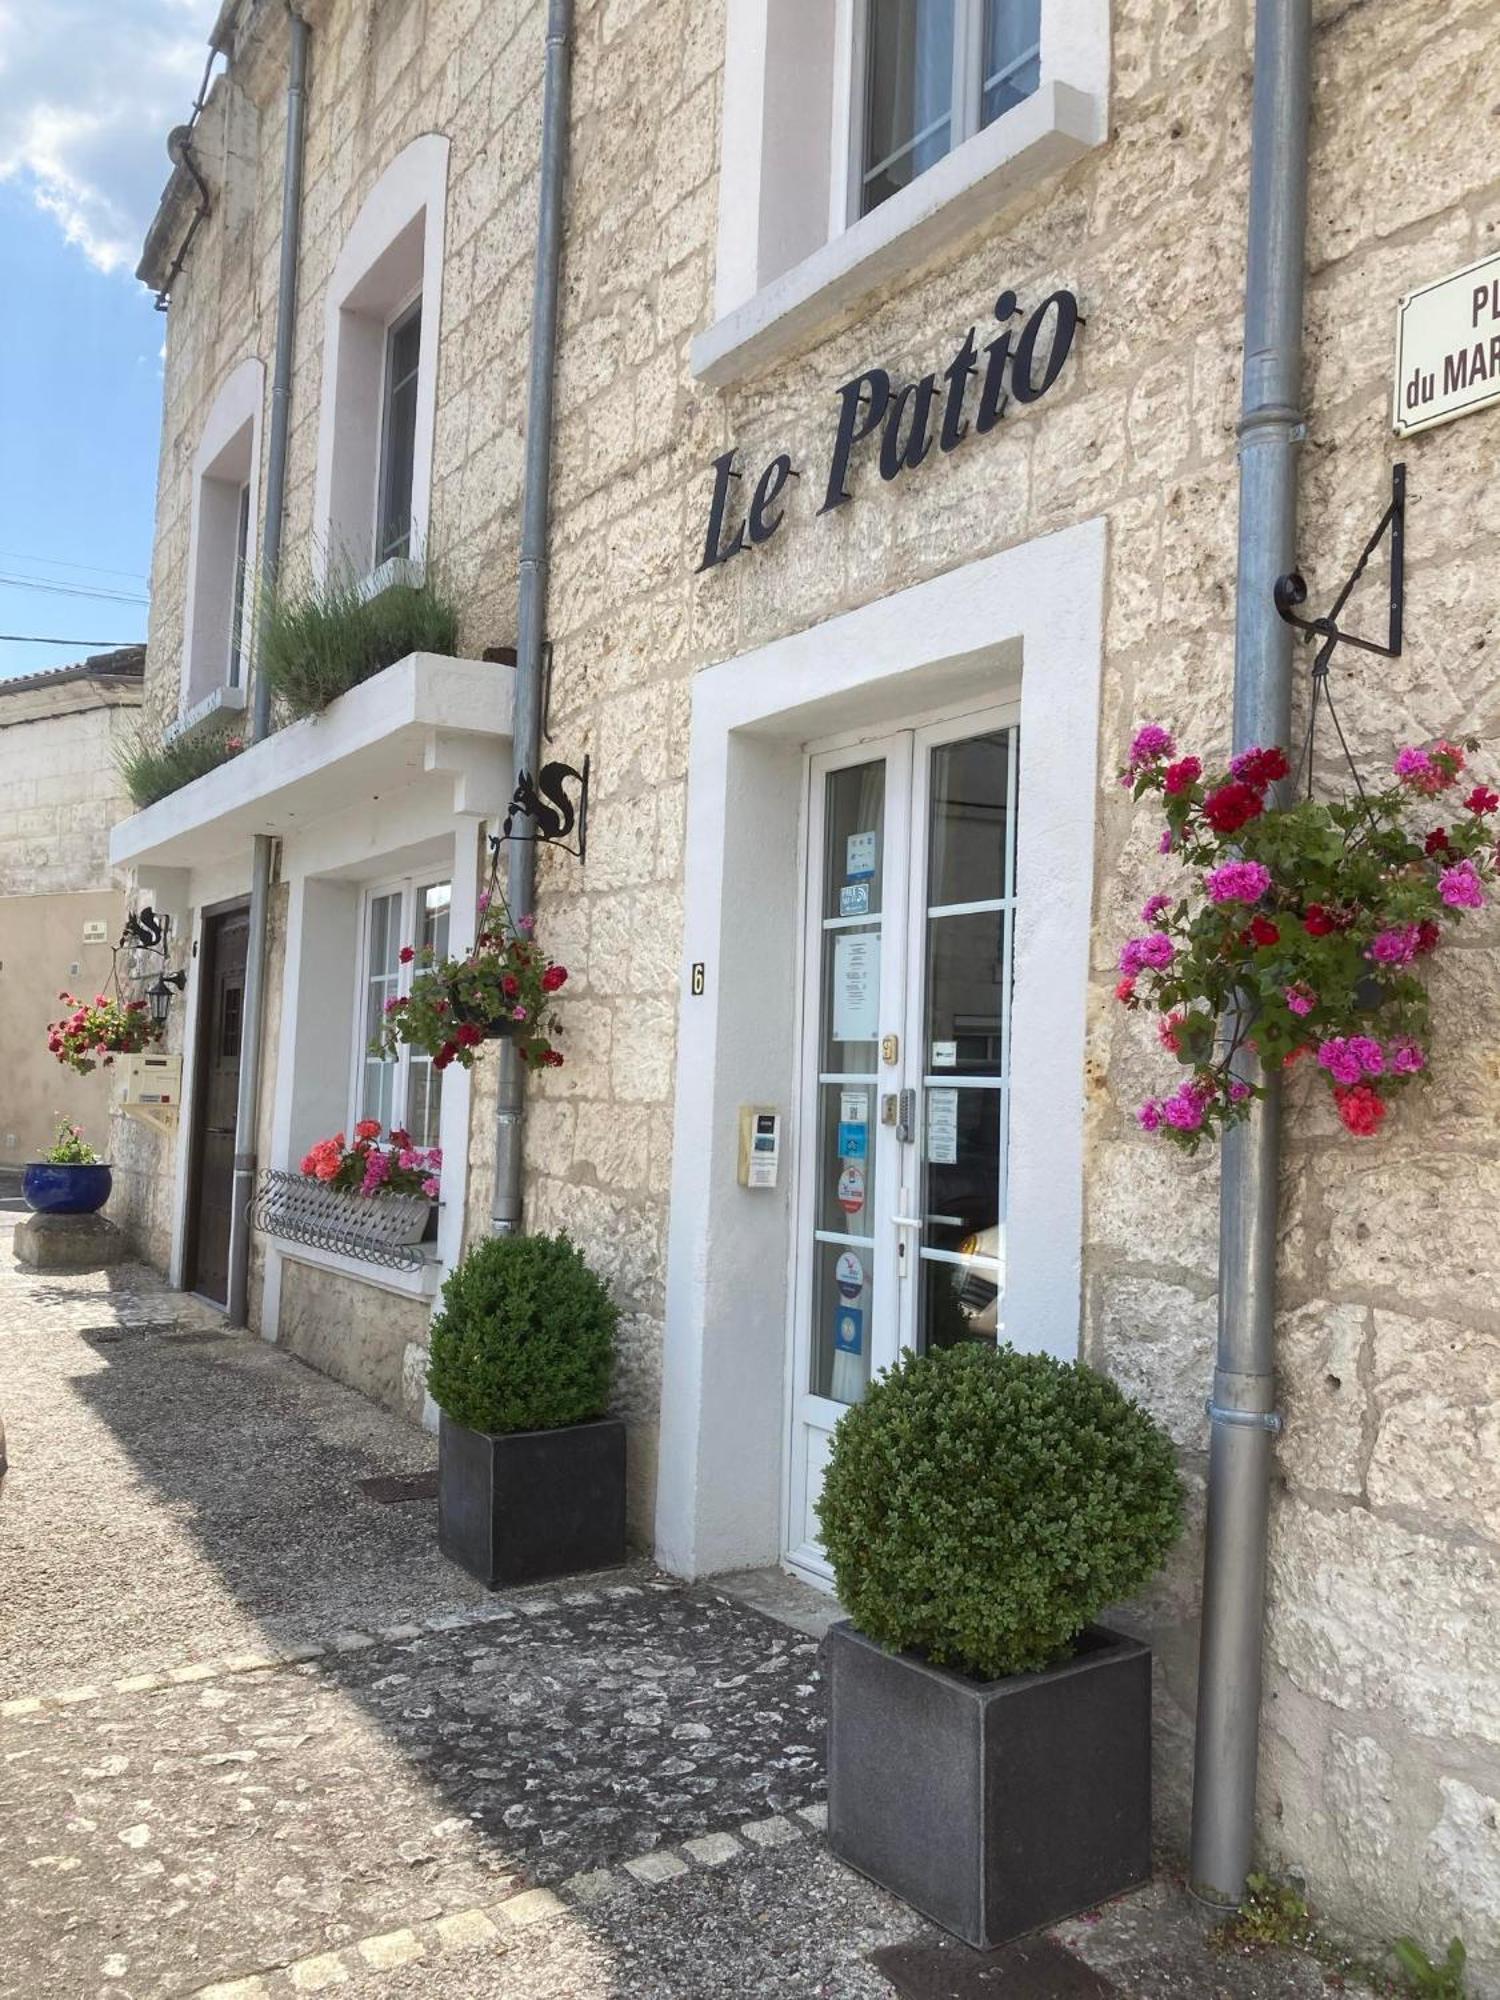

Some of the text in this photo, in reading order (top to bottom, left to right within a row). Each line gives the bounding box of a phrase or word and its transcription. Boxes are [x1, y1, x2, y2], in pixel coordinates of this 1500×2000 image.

[1407, 336, 1500, 409] du MAR
[695, 289, 1079, 574] Le Patio
[694, 965, 703, 994] 6
